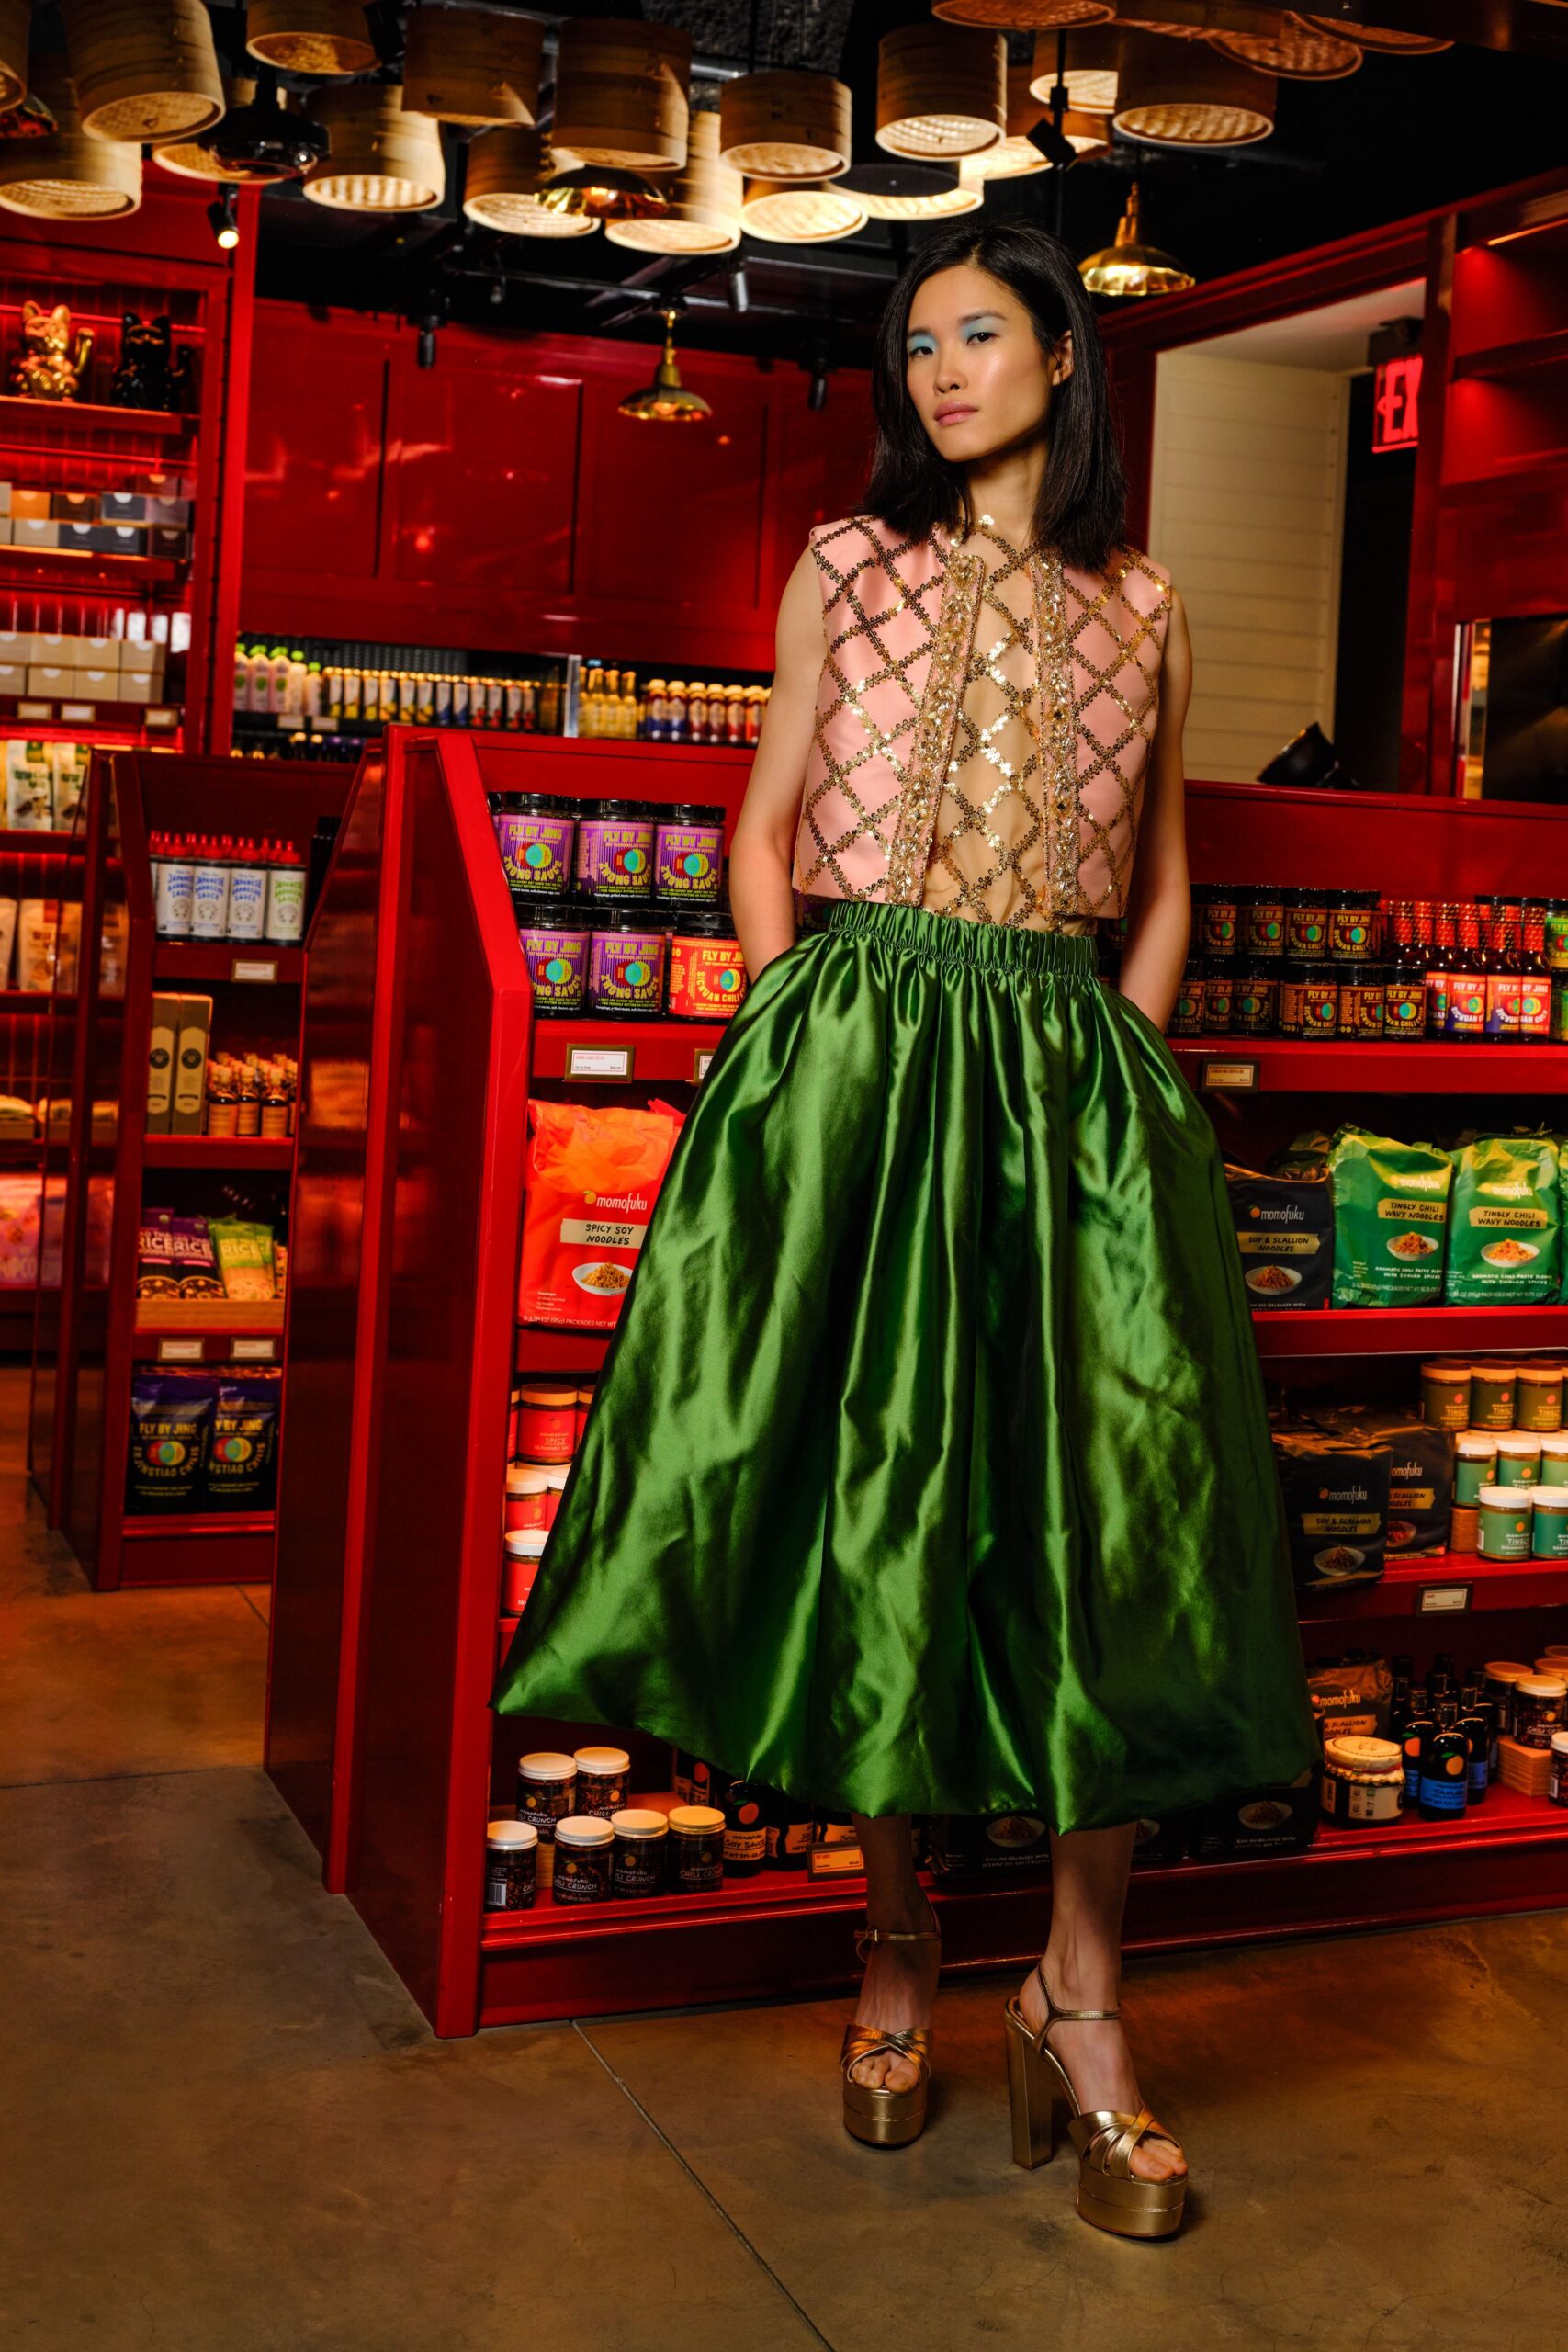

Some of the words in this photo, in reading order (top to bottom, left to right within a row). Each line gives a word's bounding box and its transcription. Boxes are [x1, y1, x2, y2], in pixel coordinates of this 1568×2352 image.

[1382, 357, 1423, 443] EX
[509, 825, 524, 835] FLY
[525, 826, 538, 836] BY
[540, 827, 562, 840] JING
[604, 831, 619, 842] FLY
[622, 831, 635, 842] BY
[666, 834, 679, 845] FLY
[682, 836, 695, 846] BY
[697, 837, 717, 848] JING
[526, 940, 544, 952] FLY
[545, 941, 558, 952] BY
[560, 942, 581, 953] JING
[605, 943, 621, 953] FLY
[623, 943, 637, 954] BY
[639, 944, 659, 955] JING
[702, 950, 718, 961] FLY
[720, 951, 732, 962] BY
[697, 970, 720, 1002] SICHUAN
[722, 994, 739, 1002] CHILI
[1453, 982, 1466, 990] FLY
[1498, 984, 1511, 992] FLY
[1308, 990, 1319, 999] FLY
[596, 1193, 648, 1214] momofuku
[1419, 1204, 1439, 1213] CHILI
[1261, 1204, 1304, 1225] momofuku
[1408, 1213, 1444, 1221] NOODLES
[585, 1224, 612, 1233] SPICY
[615, 1227, 634, 1235] SOY
[587, 1236, 629, 1245] NOODLES
[140, 1423, 155, 1434] FLY
[158, 1424, 171, 1434] BY
[174, 1423, 197, 1435] JING
[224, 1420, 237, 1431] BY
[239, 1419, 263, 1431] JING
[1391, 1462, 1423, 1480] omofuku
[1328, 1485, 1368, 1504] momofuku
[1319, 1689, 1361, 1709] momofuku
